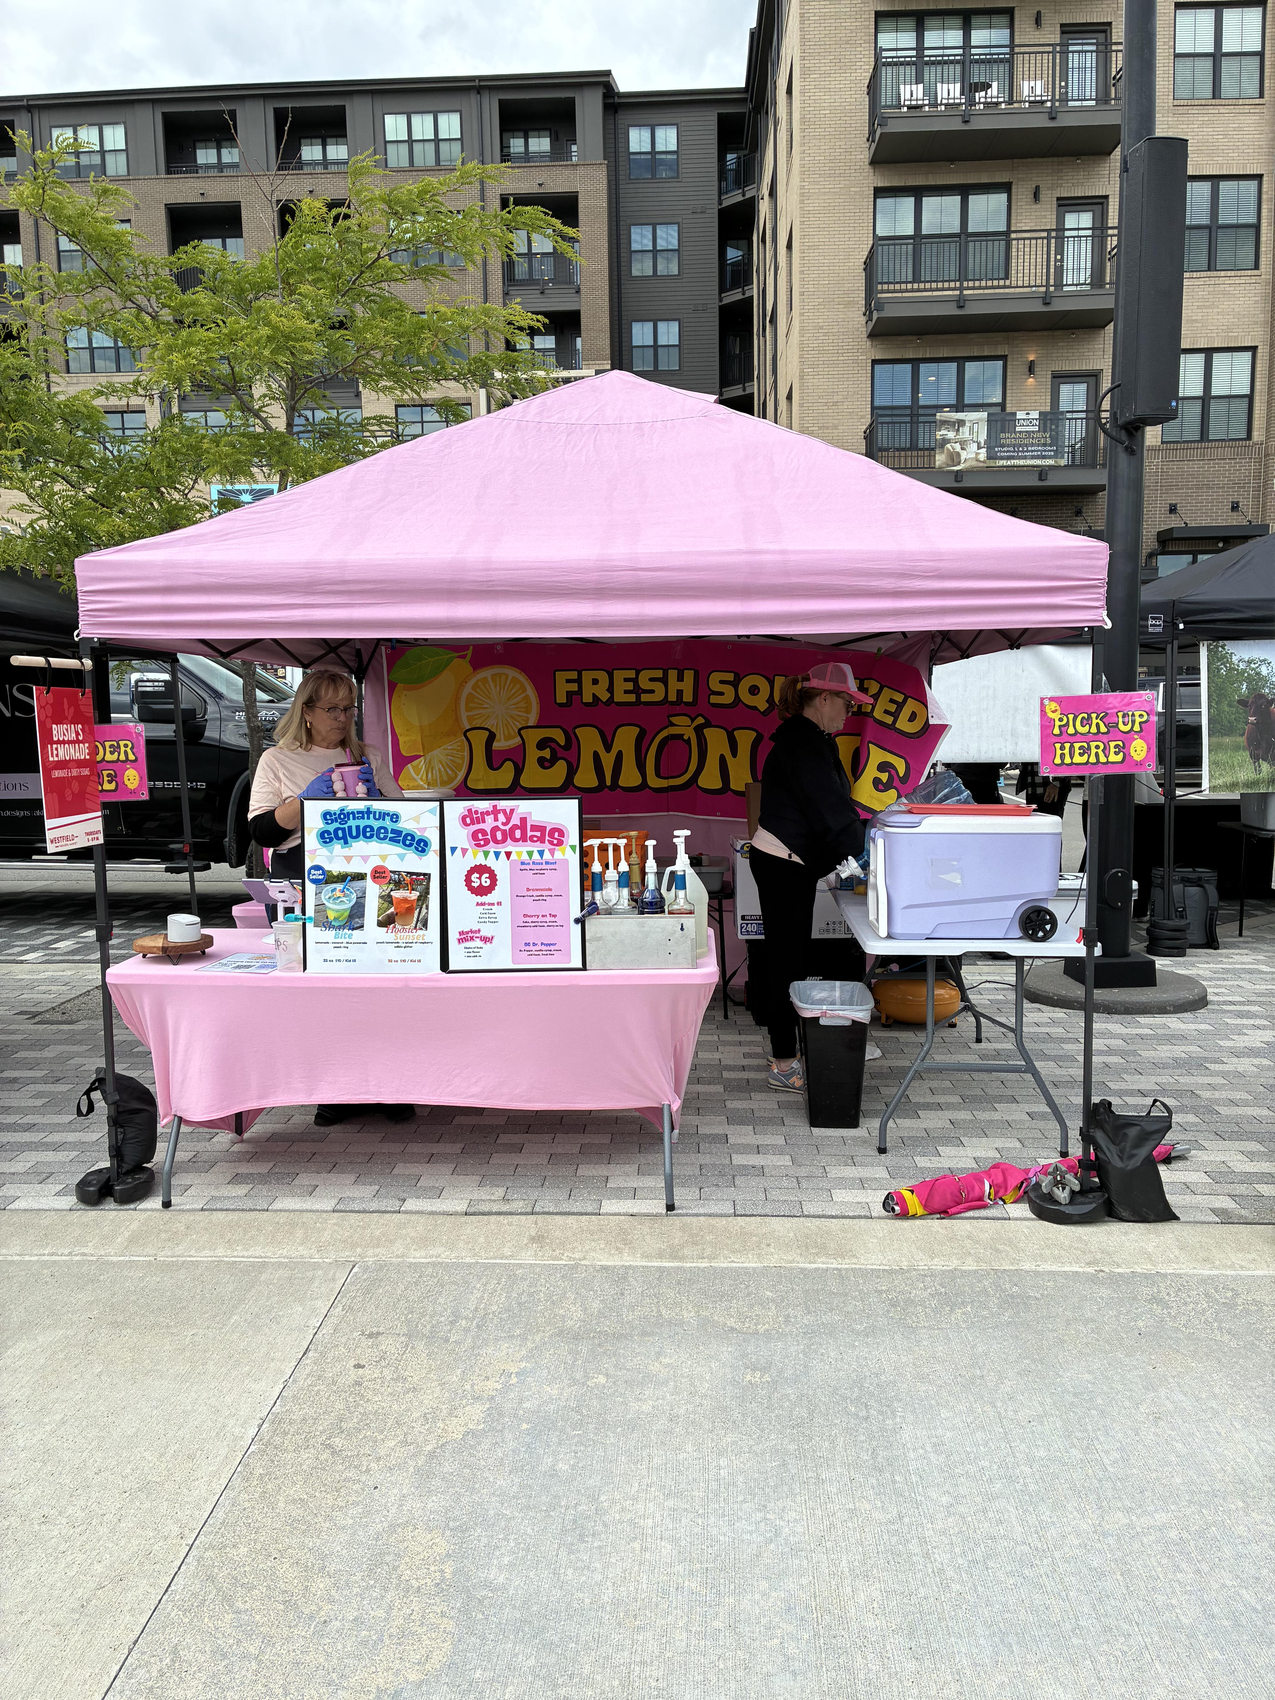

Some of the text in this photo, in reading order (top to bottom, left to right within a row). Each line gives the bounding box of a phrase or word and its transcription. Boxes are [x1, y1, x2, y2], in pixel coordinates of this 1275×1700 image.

[553, 668, 930, 738] FRESH SQUZED
[1052, 710, 1150, 735] PICK-UP
[52, 724, 83, 741] BUSIA'S
[48, 744, 90, 761] LEMONADE
[95, 740, 137, 763] DER
[1053, 741, 1126, 766] HERE
[463, 713, 911, 815] LEMONE
[461, 804, 516, 826] dirty
[50, 833, 74, 845] WESTFIELD
[320, 825, 428, 854] squeezes
[471, 816, 565, 848] sodas
[471, 872, 490, 888] $6
[320, 921, 355, 932] Shark
[458, 928, 481, 937] Market
[742, 924, 756, 932] 240
[334, 931, 353, 940] Bite
[456, 935, 494, 945] mix-up!
